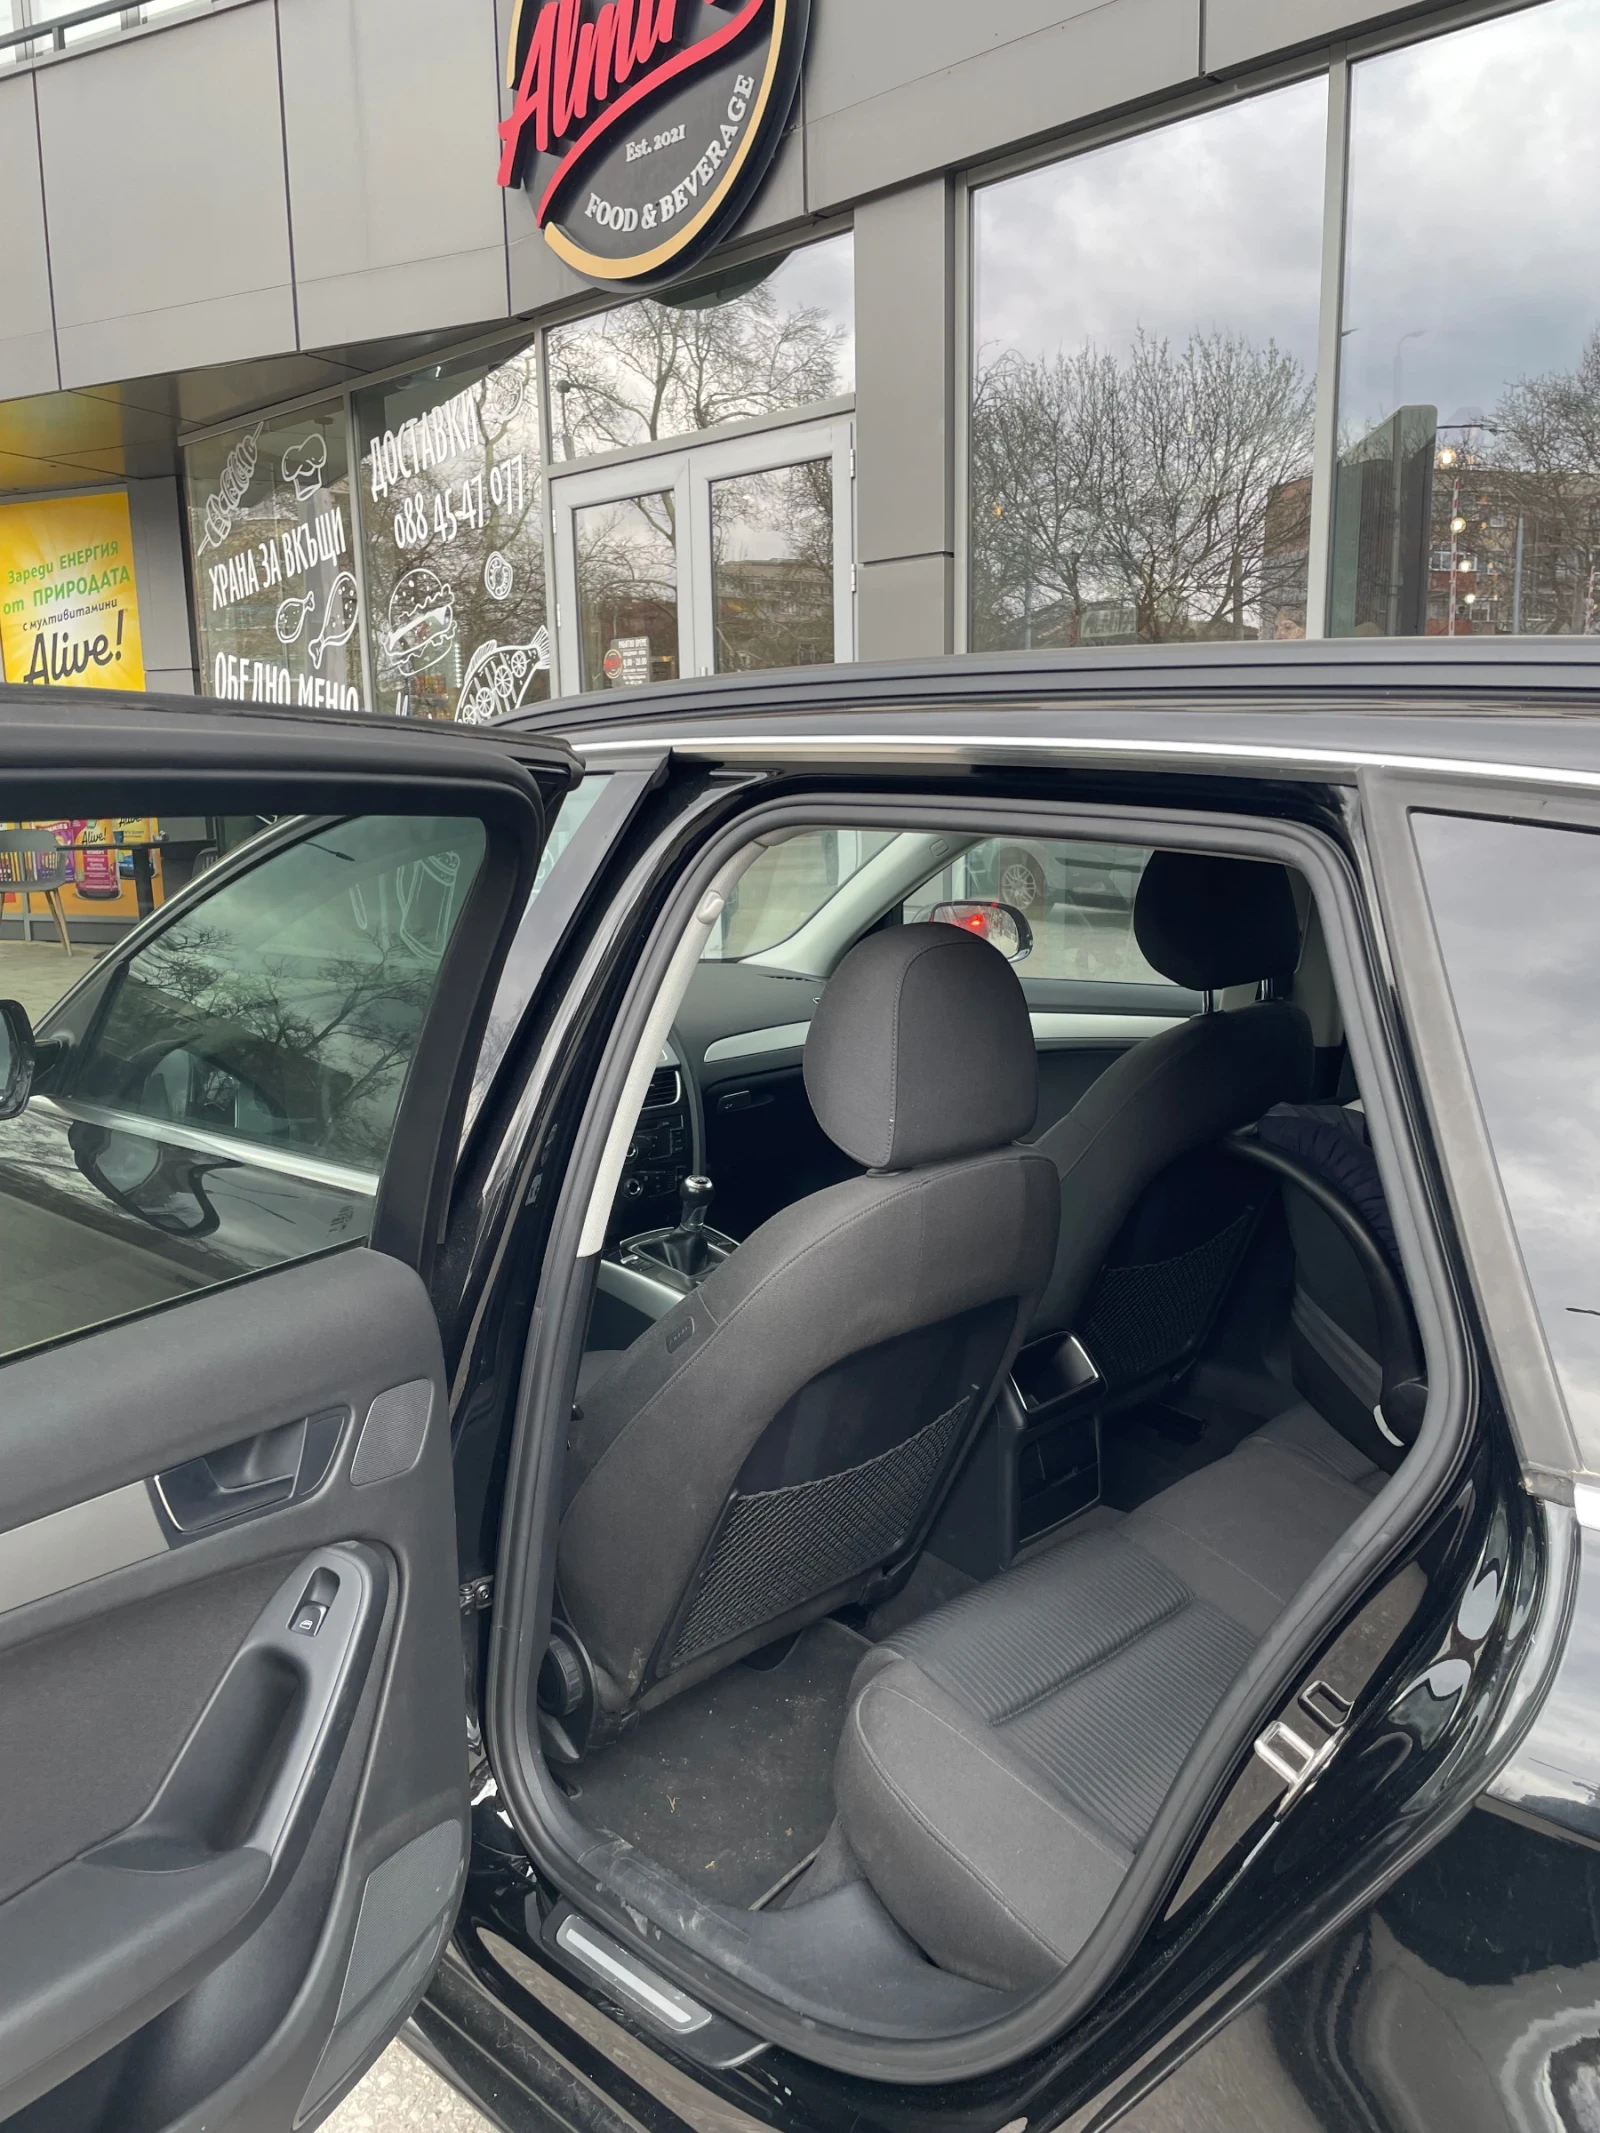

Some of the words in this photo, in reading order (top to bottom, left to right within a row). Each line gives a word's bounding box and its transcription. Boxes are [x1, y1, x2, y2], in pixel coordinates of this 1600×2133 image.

[584, 192, 638, 232] FOOD
[641, 203, 658, 230] &
[657, 74, 754, 223] BEVERAGE
[625, 140, 652, 163] Est.
[652, 124, 687, 152] 2021
[370, 389, 481, 503] ДОСТАВКИ
[394, 492, 428, 549] 088
[490, 453, 524, 515] 077
[3, 599, 24, 616] от
[33, 565, 130, 607] ПРИРОДАТА
[8, 561, 53, 585] Зареди
[60, 540, 119, 570] ЕНЕРГИЯ
[208, 548, 260, 611] ХРАНА
[260, 540, 282, 589] ЗА
[282, 506, 347, 578] ВКЪЩИ
[23, 608, 125, 685] Alive!
[29, 598, 118, 632] мултивитамини
